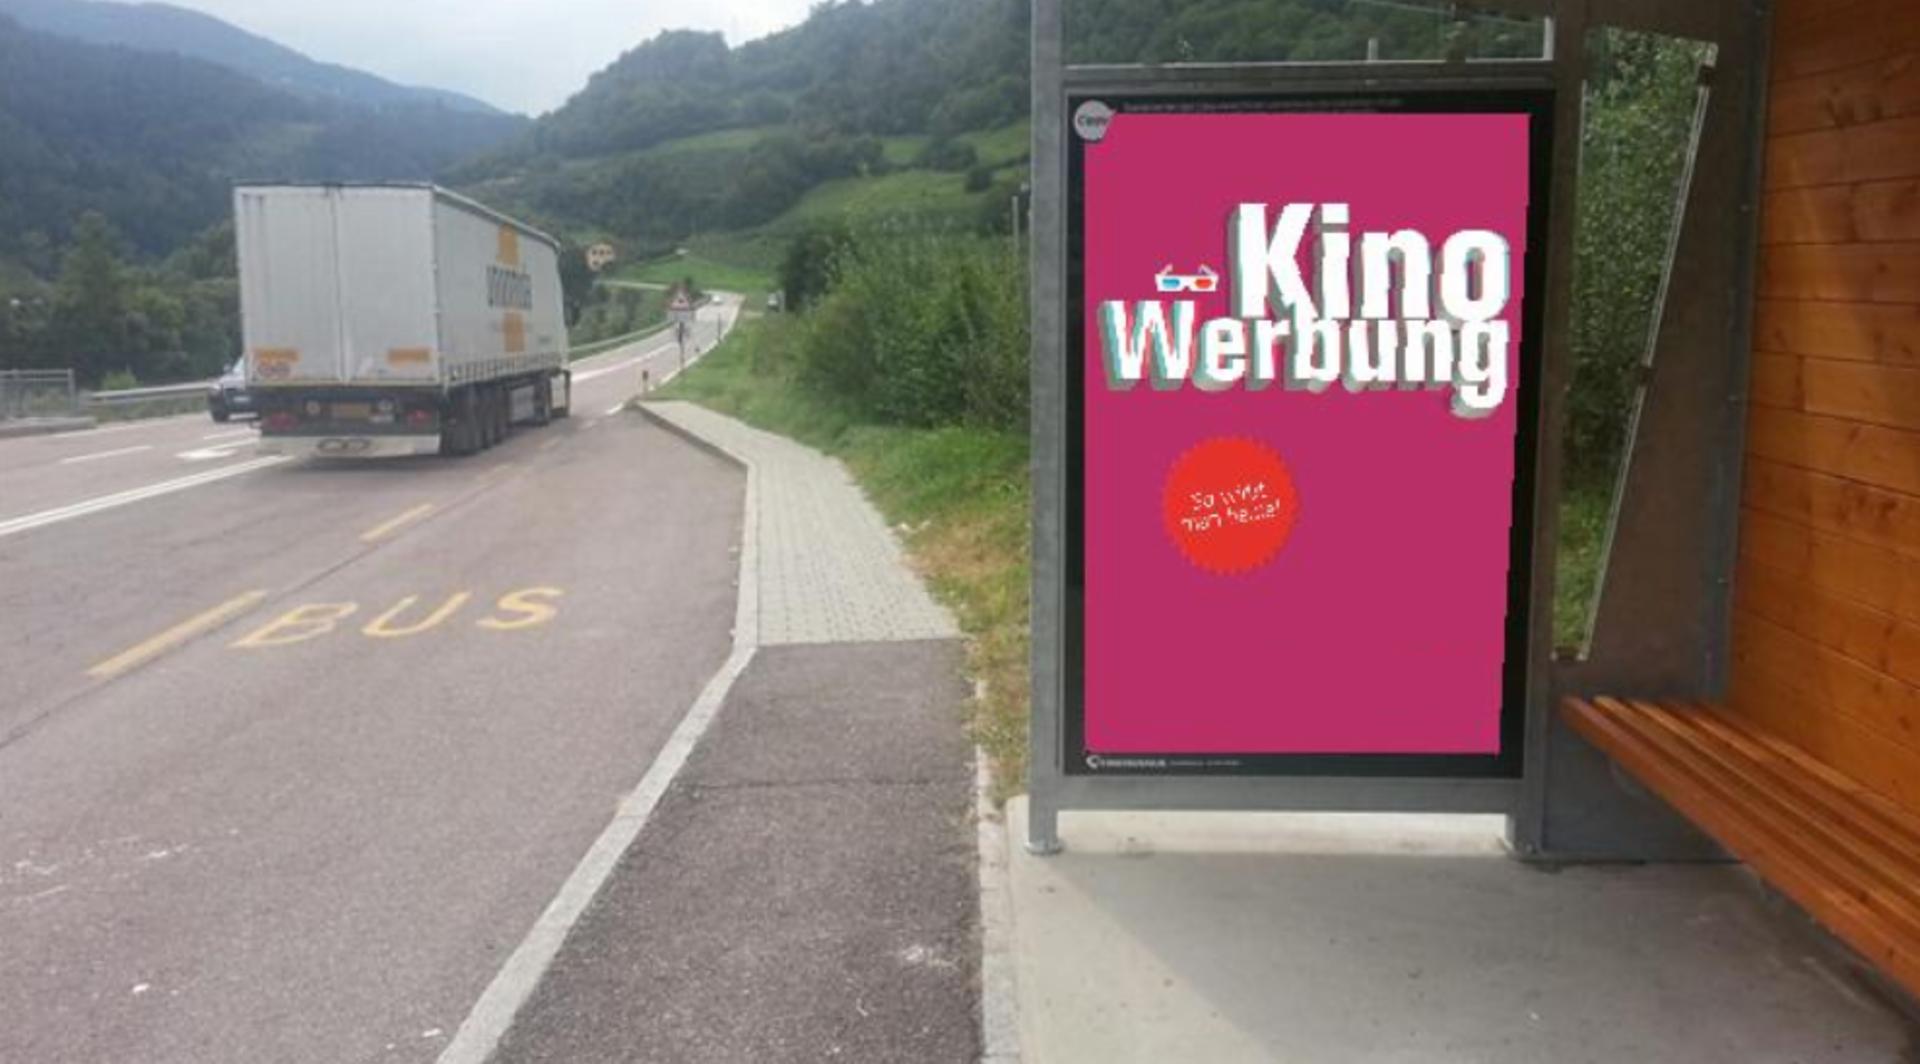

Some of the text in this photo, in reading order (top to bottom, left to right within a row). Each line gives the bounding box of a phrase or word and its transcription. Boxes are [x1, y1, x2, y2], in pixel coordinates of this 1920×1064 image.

[1230, 203, 1509, 321] Kino
[1101, 301, 1508, 416] Werbung
[229, 587, 564, 648] BUS
